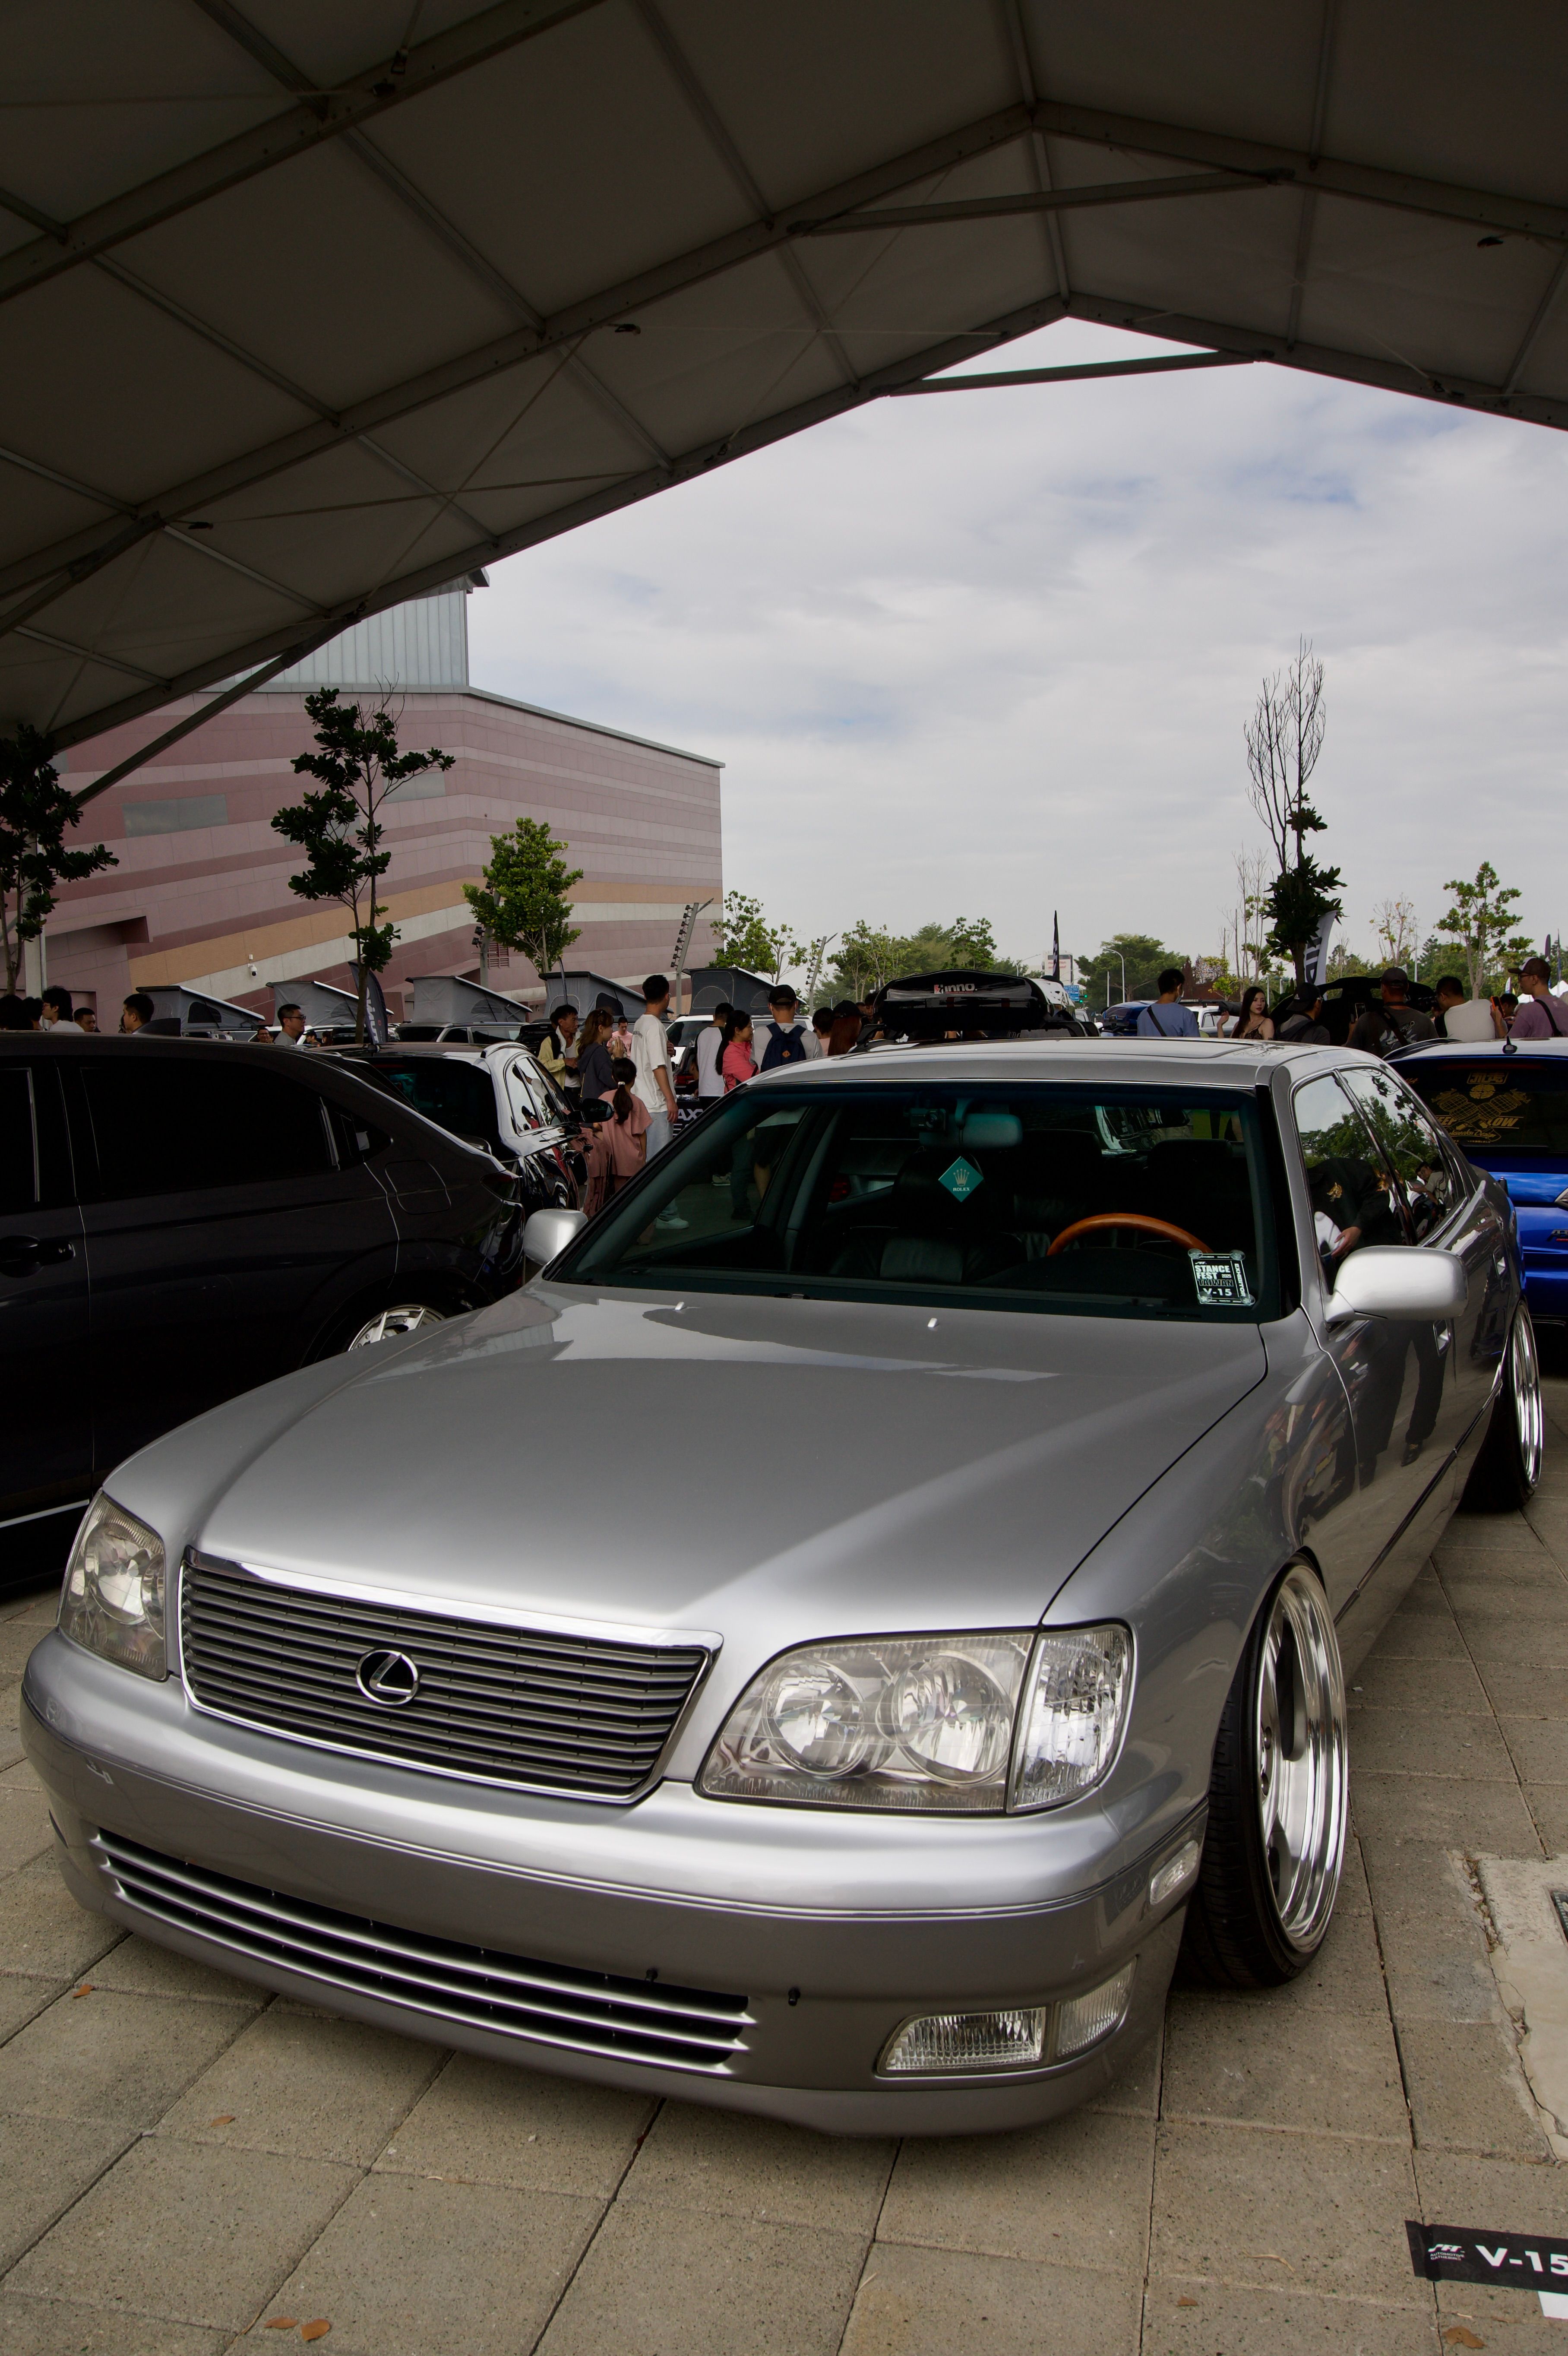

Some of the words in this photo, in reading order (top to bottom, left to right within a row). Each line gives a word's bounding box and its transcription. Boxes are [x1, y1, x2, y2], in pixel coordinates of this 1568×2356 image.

[1198, 1279, 1234, 1287] TAIWAN
[1234, 1263, 1246, 1297] EXHIBITOR
[1203, 1288, 1233, 1296] V-15
[1475, 2244, 1568, 2276] V-15
